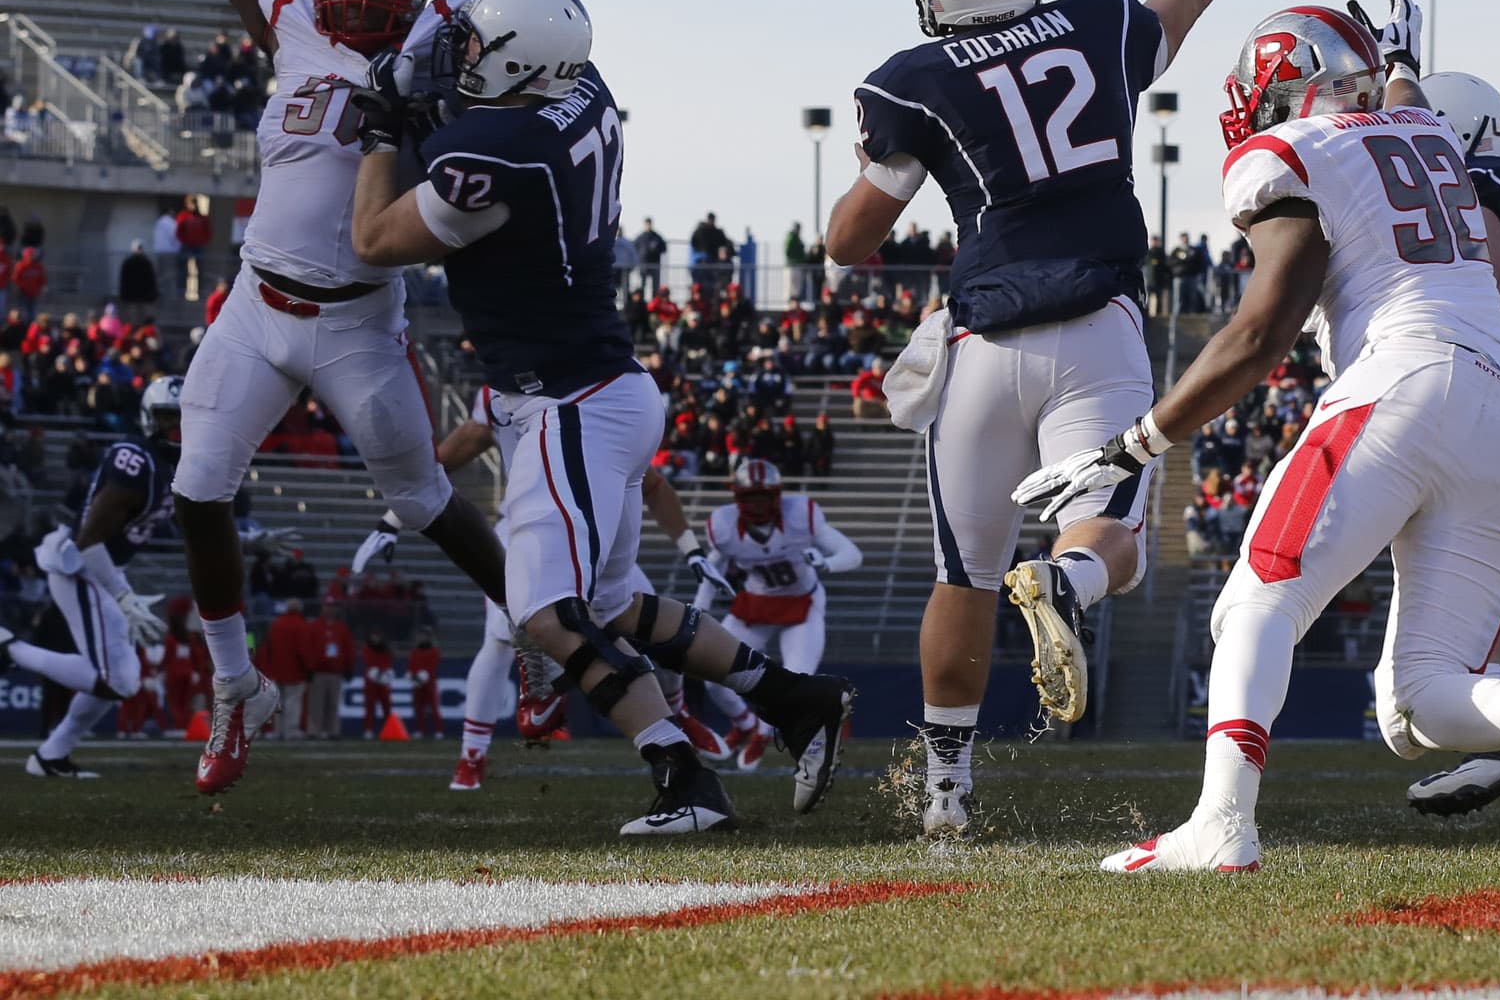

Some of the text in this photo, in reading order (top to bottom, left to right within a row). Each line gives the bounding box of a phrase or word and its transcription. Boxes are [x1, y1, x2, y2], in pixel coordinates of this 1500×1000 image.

[942, 9, 1075, 69] COCHRAN
[972, 9, 1016, 26] HUSKIES
[1253, 31, 1303, 90] R
[976, 47, 1120, 185] 12
[443, 166, 494, 209] 72
[568, 105, 625, 246] 72
[1363, 134, 1493, 265] 92
[114, 447, 146, 477] 85
